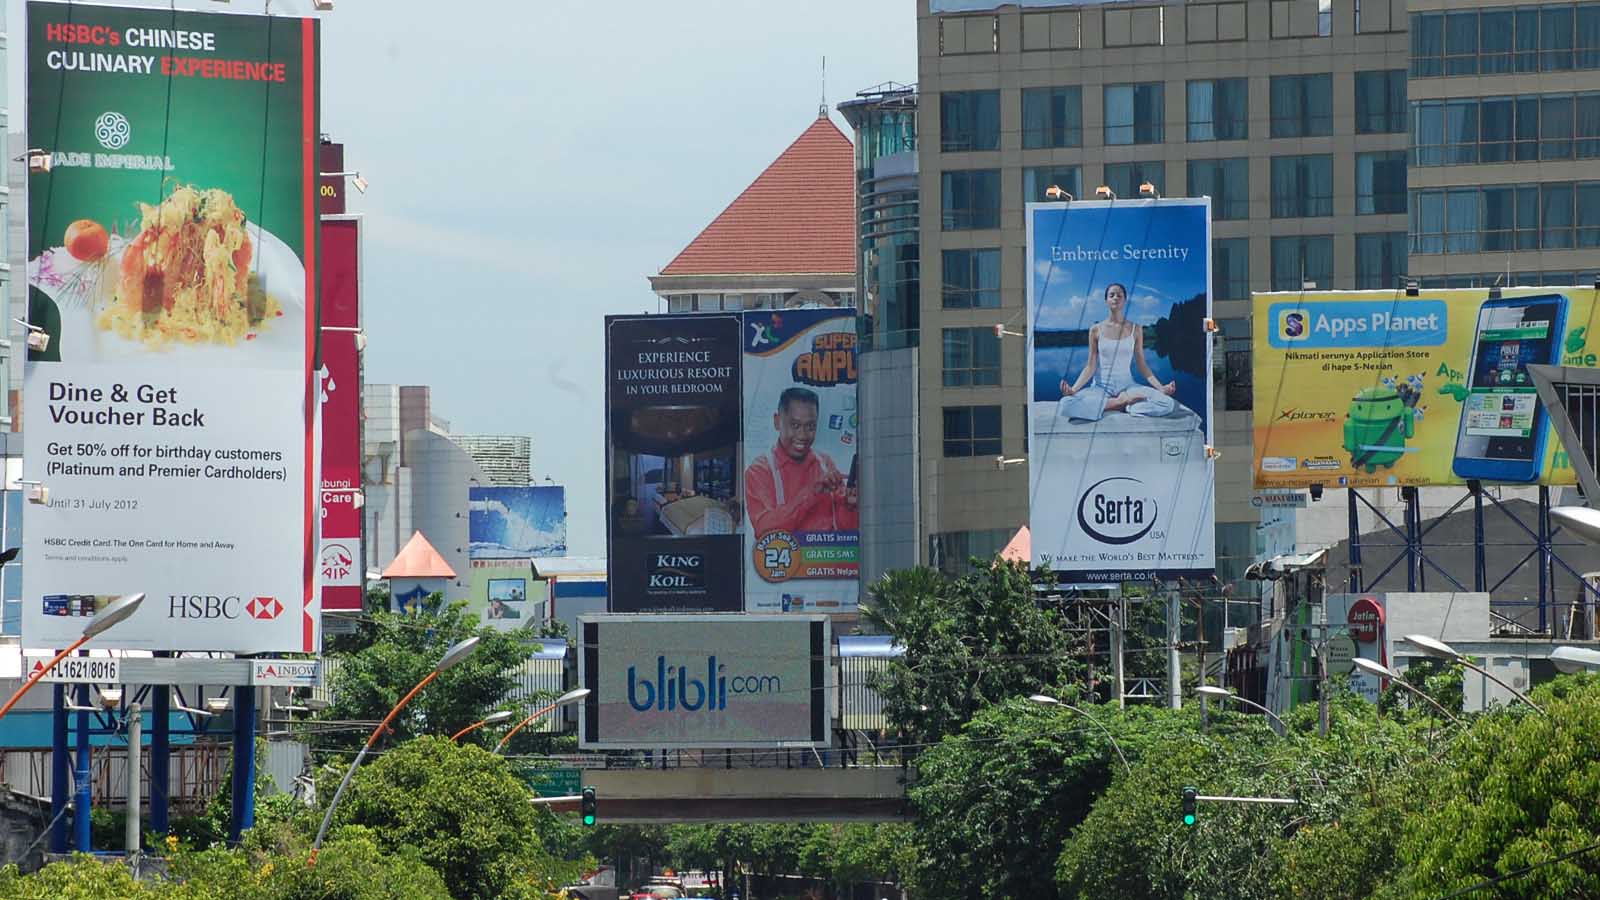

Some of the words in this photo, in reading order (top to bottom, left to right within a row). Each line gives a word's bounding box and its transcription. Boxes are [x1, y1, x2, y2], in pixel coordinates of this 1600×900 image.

[47, 23, 121, 46] HSBC's
[125, 28, 216, 51] CHINESE
[47, 51, 155, 75] CULINARY
[161, 56, 286, 83] EXPERIENCE
[95, 153, 175, 171] IMPERIAL
[1050, 244, 1120, 263] Embrace
[1123, 243, 1189, 262] Serenity
[1314, 313, 1367, 338] Apps
[1372, 311, 1439, 332] Planet
[638, 351, 711, 364] EXPERIENCE
[1285, 351, 1319, 361] Nikmati
[1321, 351, 1355, 361] serunya
[1356, 350, 1405, 361] Application
[1406, 350, 1430, 359] Store
[617, 367, 684, 381] LUXURIOUS
[687, 366, 733, 379] RESORT
[1322, 363, 1331, 371] di
[1331, 363, 1352, 372] hape
[49, 382, 103, 402] Dine
[110, 383, 129, 403] &
[136, 384, 177, 404] Get
[626, 385, 638, 395] IN
[640, 384, 670, 395] YOUR
[671, 382, 723, 394] BEDROOM
[49, 405, 145, 427] Voucher
[152, 407, 205, 428] Back
[47, 443, 73, 456] Get
[76, 443, 107, 457] 50%
[110, 444, 131, 457] off
[133, 445, 152, 458] for
[155, 445, 211, 462] birthday
[214, 448, 282, 461] customers
[46, 461, 115, 477] (Platinum
[119, 463, 145, 477] and
[148, 463, 201, 478] Premier
[204, 465, 287, 482] Cardholders)
[74, 498, 86, 509] 31
[88, 498, 111, 512] July
[113, 499, 138, 510] 2012
[322, 492, 352, 503] Care
[1094, 494, 1143, 525] Serta
[806, 534, 835, 542] GRATIS
[1149, 529, 1165, 540] USA
[44, 538, 67, 547] HSBC
[68, 538, 91, 547] Credit
[113, 539, 127, 548] The
[128, 539, 144, 548] One
[145, 540, 163, 549] Card
[164, 540, 175, 548] for
[176, 540, 198, 549] Home
[199, 541, 213, 549] and
[214, 541, 235, 550] Away
[656, 555, 700, 567] KING
[765, 548, 791, 568] 24
[321, 567, 350, 580] AIA
[806, 568, 835, 576] GRATIS
[649, 575, 689, 587] KOIL
[168, 595, 241, 620] HSBC
[627, 655, 781, 712] blibli.com
